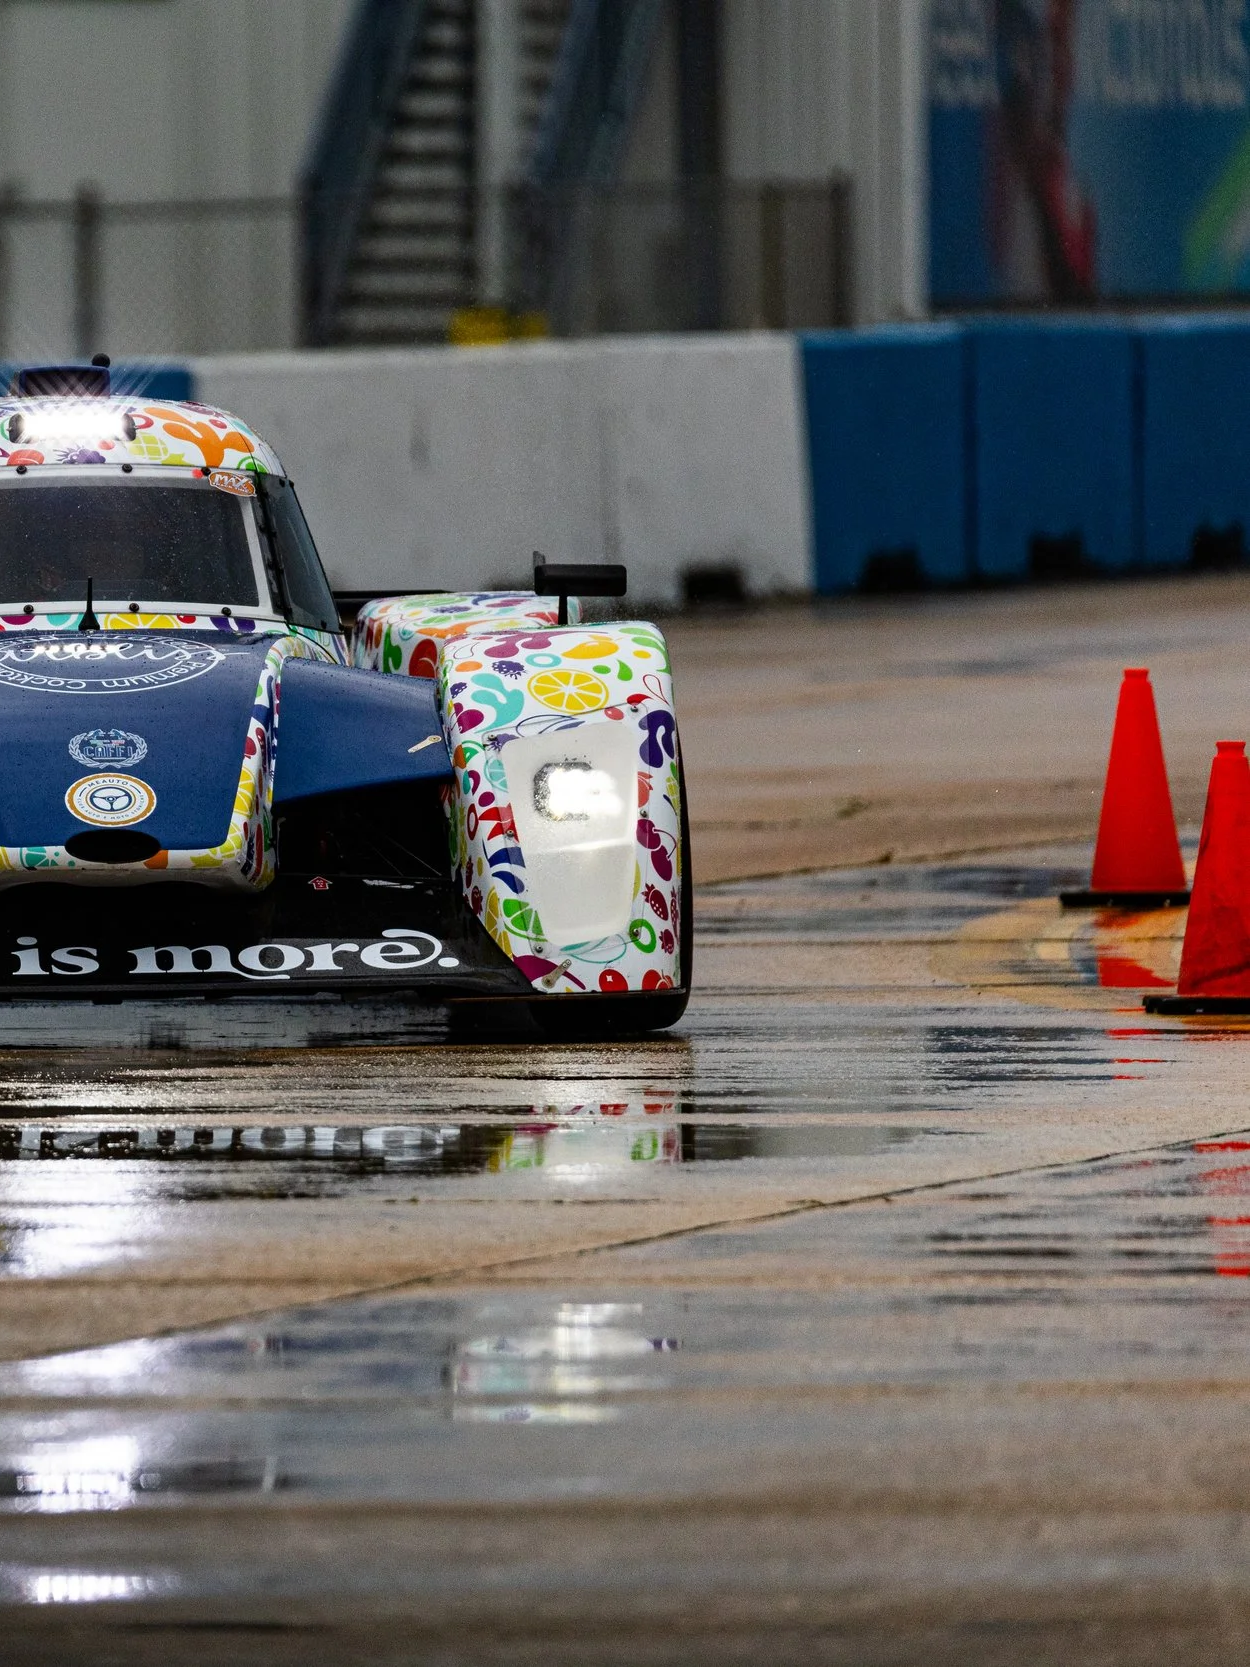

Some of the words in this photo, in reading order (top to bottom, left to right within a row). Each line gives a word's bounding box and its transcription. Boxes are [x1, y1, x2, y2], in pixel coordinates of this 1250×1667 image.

[214, 473, 253, 489] MAX
[102, 661, 206, 688] Premium
[88, 779, 129, 787] MEAUTO
[85, 809, 101, 818] AUTO
[11, 935, 99, 977] is
[128, 928, 461, 981] more.
